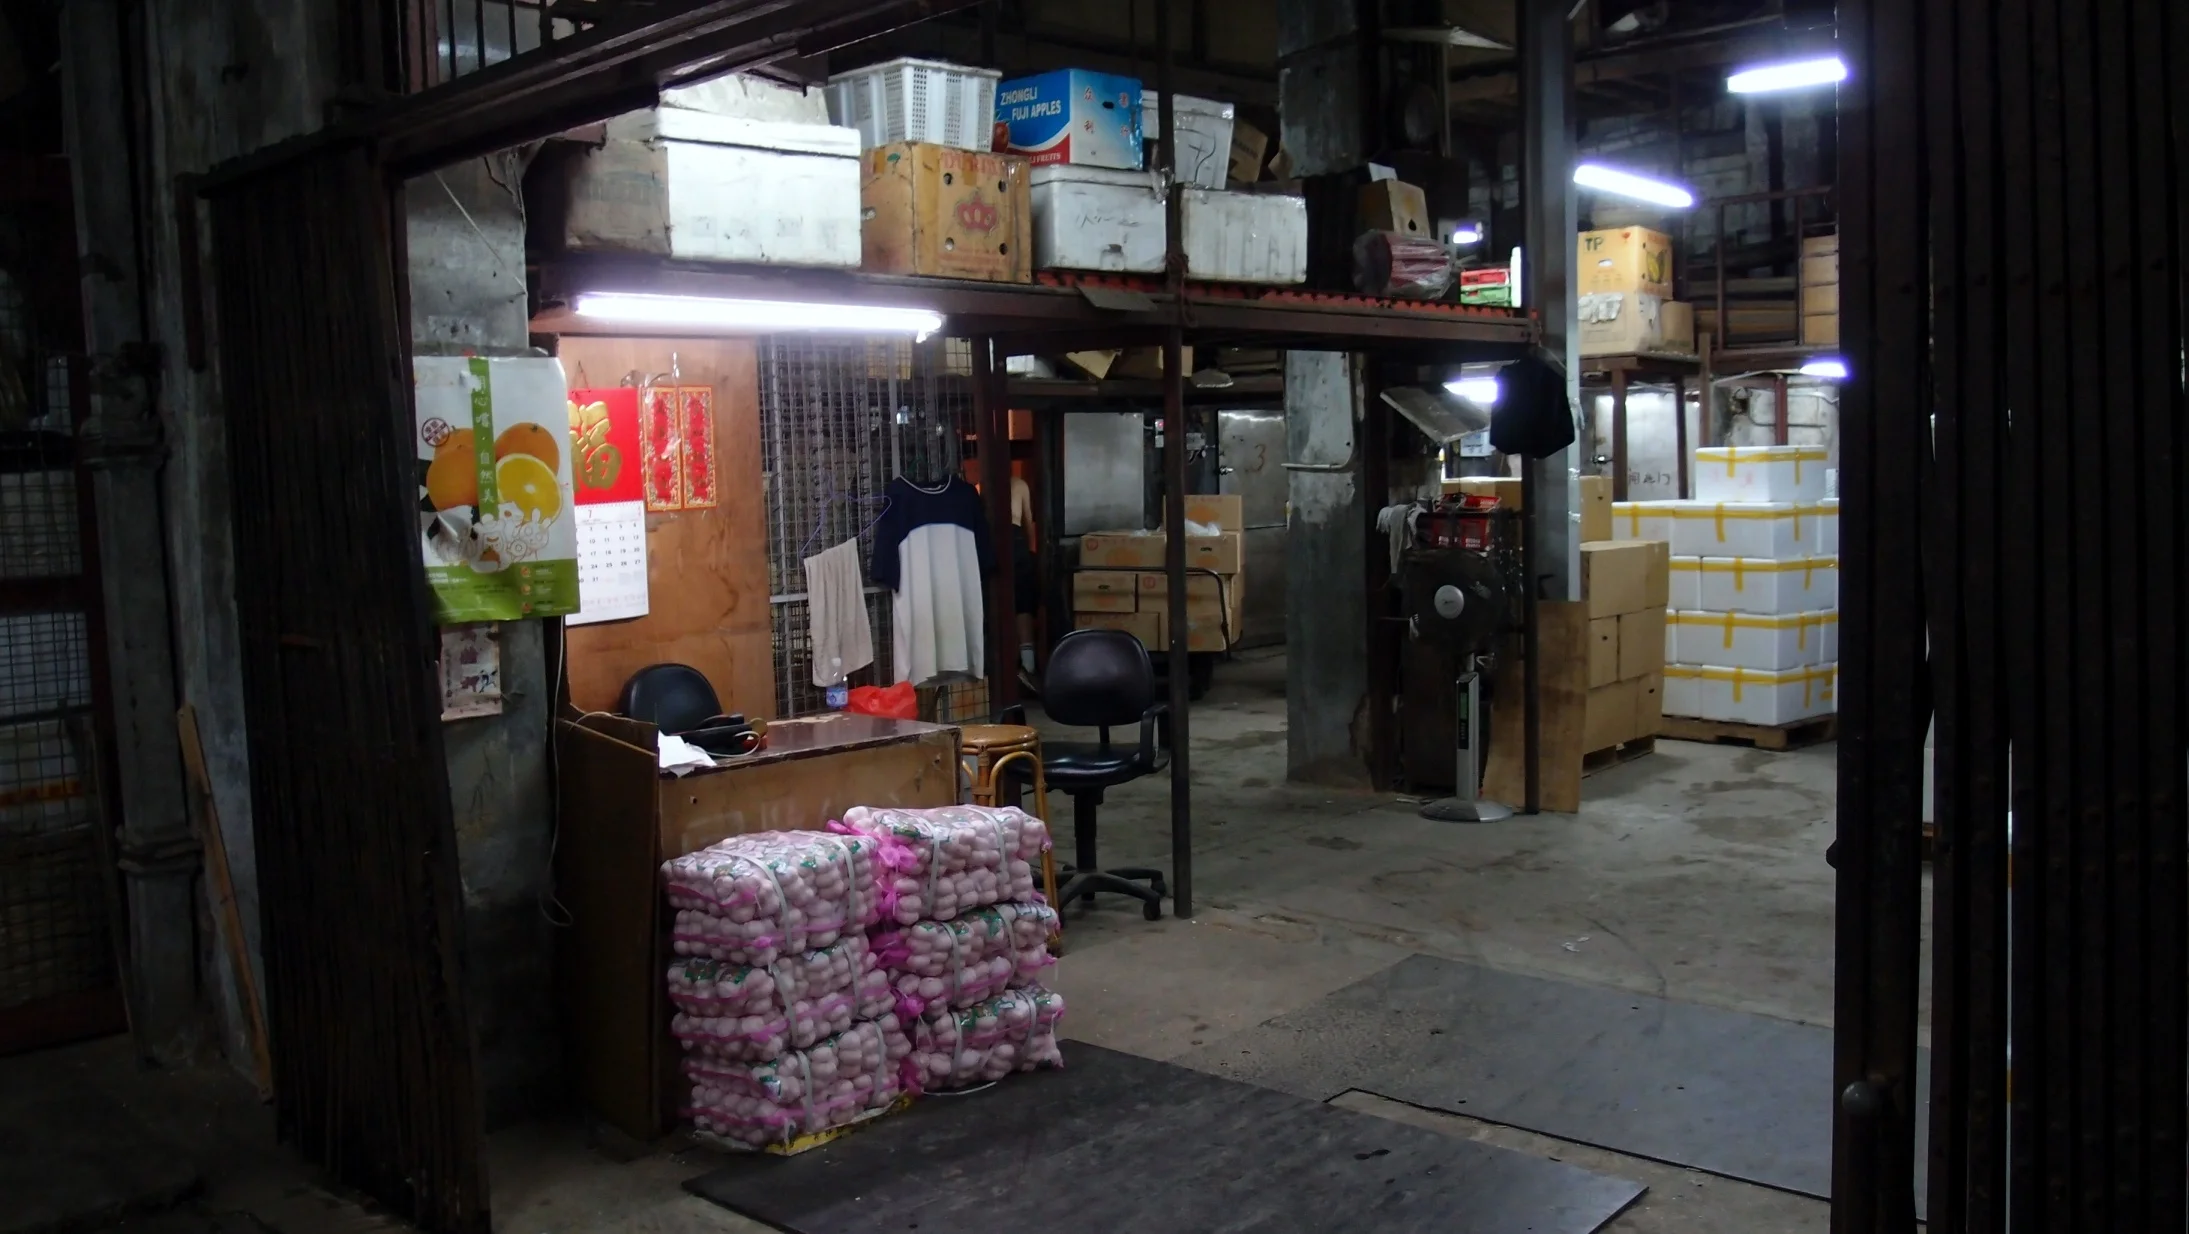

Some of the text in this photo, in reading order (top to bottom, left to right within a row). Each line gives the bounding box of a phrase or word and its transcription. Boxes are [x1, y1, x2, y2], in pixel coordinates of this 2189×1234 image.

[1000, 87, 1038, 106] ZHONGLI
[1012, 100, 1061, 121] FUJI APPLES
[1584, 237, 1603, 252] TP
[1246, 443, 1266, 473] 3
